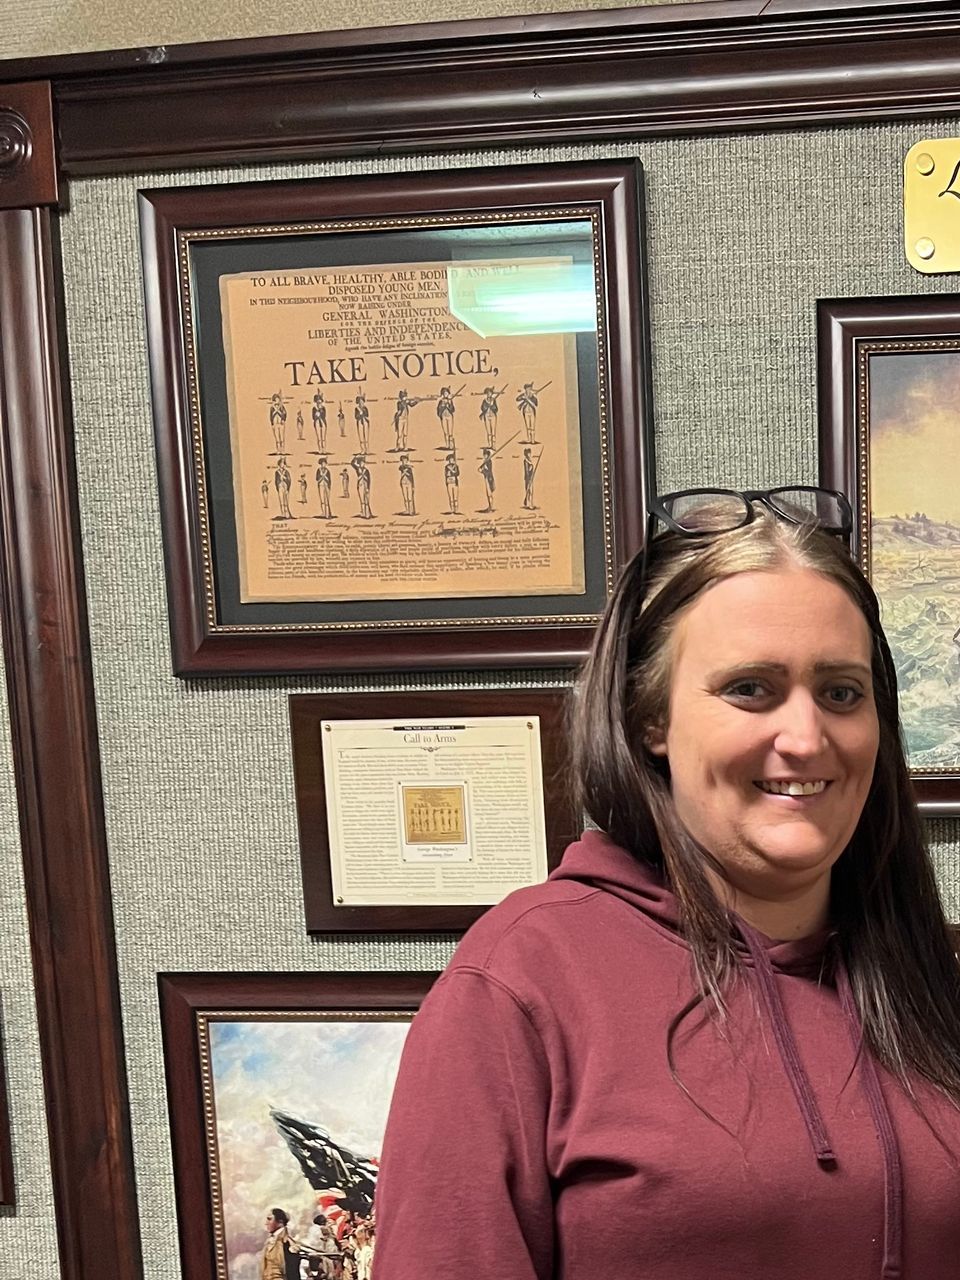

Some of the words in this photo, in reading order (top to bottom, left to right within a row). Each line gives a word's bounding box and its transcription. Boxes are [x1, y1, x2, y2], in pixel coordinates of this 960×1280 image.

[251, 277, 266, 287] TO
[270, 276, 291, 287] ALL
[390, 271, 417, 282] ABLE
[328, 285, 375, 296] DISPOSED
[379, 282, 414, 294] YOUNG
[384, 293, 398, 301] ANY
[322, 311, 373, 322] GENERAL
[308, 327, 361, 339] LIBERTIES
[364, 326, 386, 337] AND
[328, 338, 338, 346] OF
[344, 337, 362, 345] THE
[367, 334, 406, 344] UNITED
[284, 357, 368, 386] TAKE
[380, 349, 499, 380] NOTICE,
[403, 733, 421, 744] Call
[423, 735, 432, 743] to
[434, 734, 457, 743] Arms
